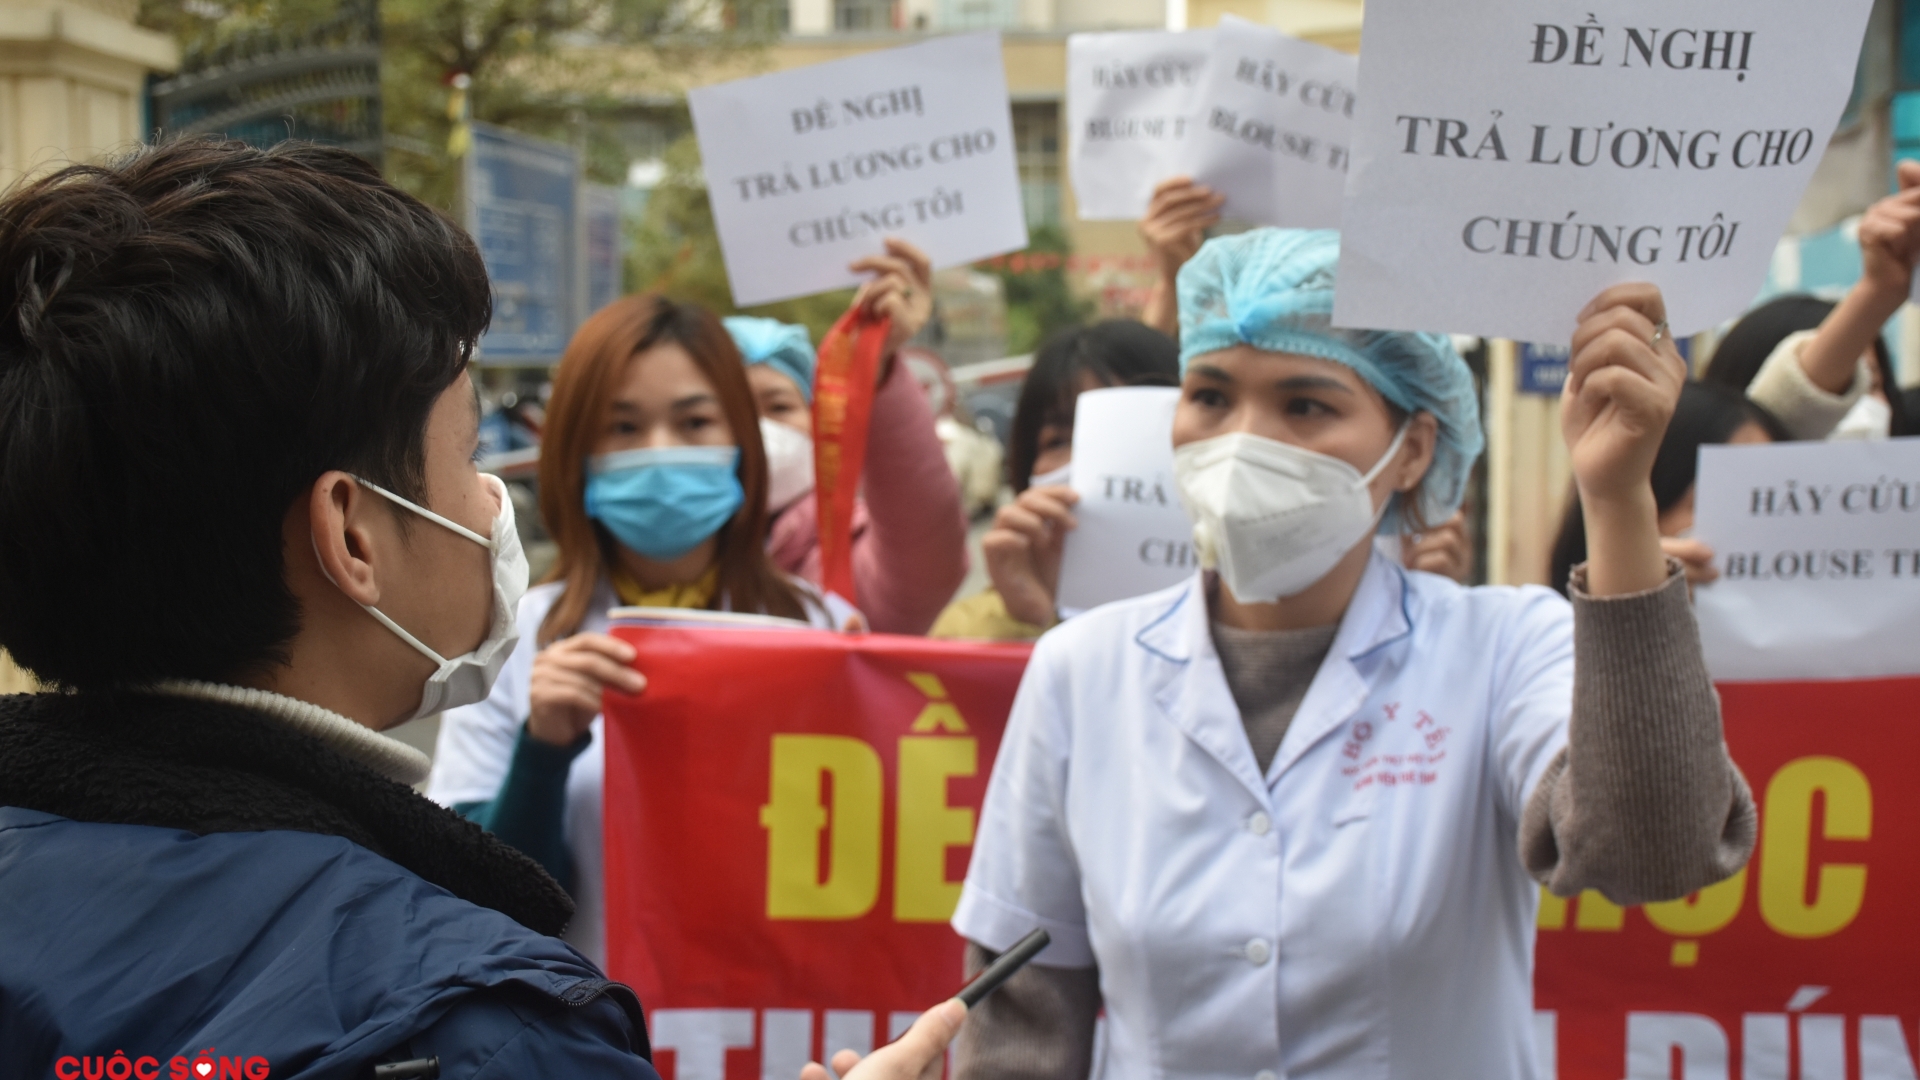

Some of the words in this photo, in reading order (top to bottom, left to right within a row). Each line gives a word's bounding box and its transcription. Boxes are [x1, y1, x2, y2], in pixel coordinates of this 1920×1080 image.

[1528, 13, 1604, 67] ĐỀ
[1619, 26, 1756, 83] NGHỊ
[842, 84, 925, 122] NGHỊ
[732, 161, 802, 202] TRẢ
[808, 141, 924, 190] LƯƠNG
[928, 126, 997, 164] CHO
[1396, 110, 1509, 162] TRẢ
[1525, 121, 1720, 170] LƯƠNG
[1732, 127, 1813, 169] CHO
[788, 202, 905, 248] CHÚNG
[911, 185, 965, 224] TÔI
[1461, 211, 1662, 266] CHÚNG
[1676, 211, 1740, 264] TÔI
[1751, 480, 1831, 516] HÃY
[1138, 537, 1198, 568] CH
[1724, 550, 1875, 581] BLOUSE
[1382, 701, 1401, 721] Y
[759, 672, 979, 922] ĐỀ
